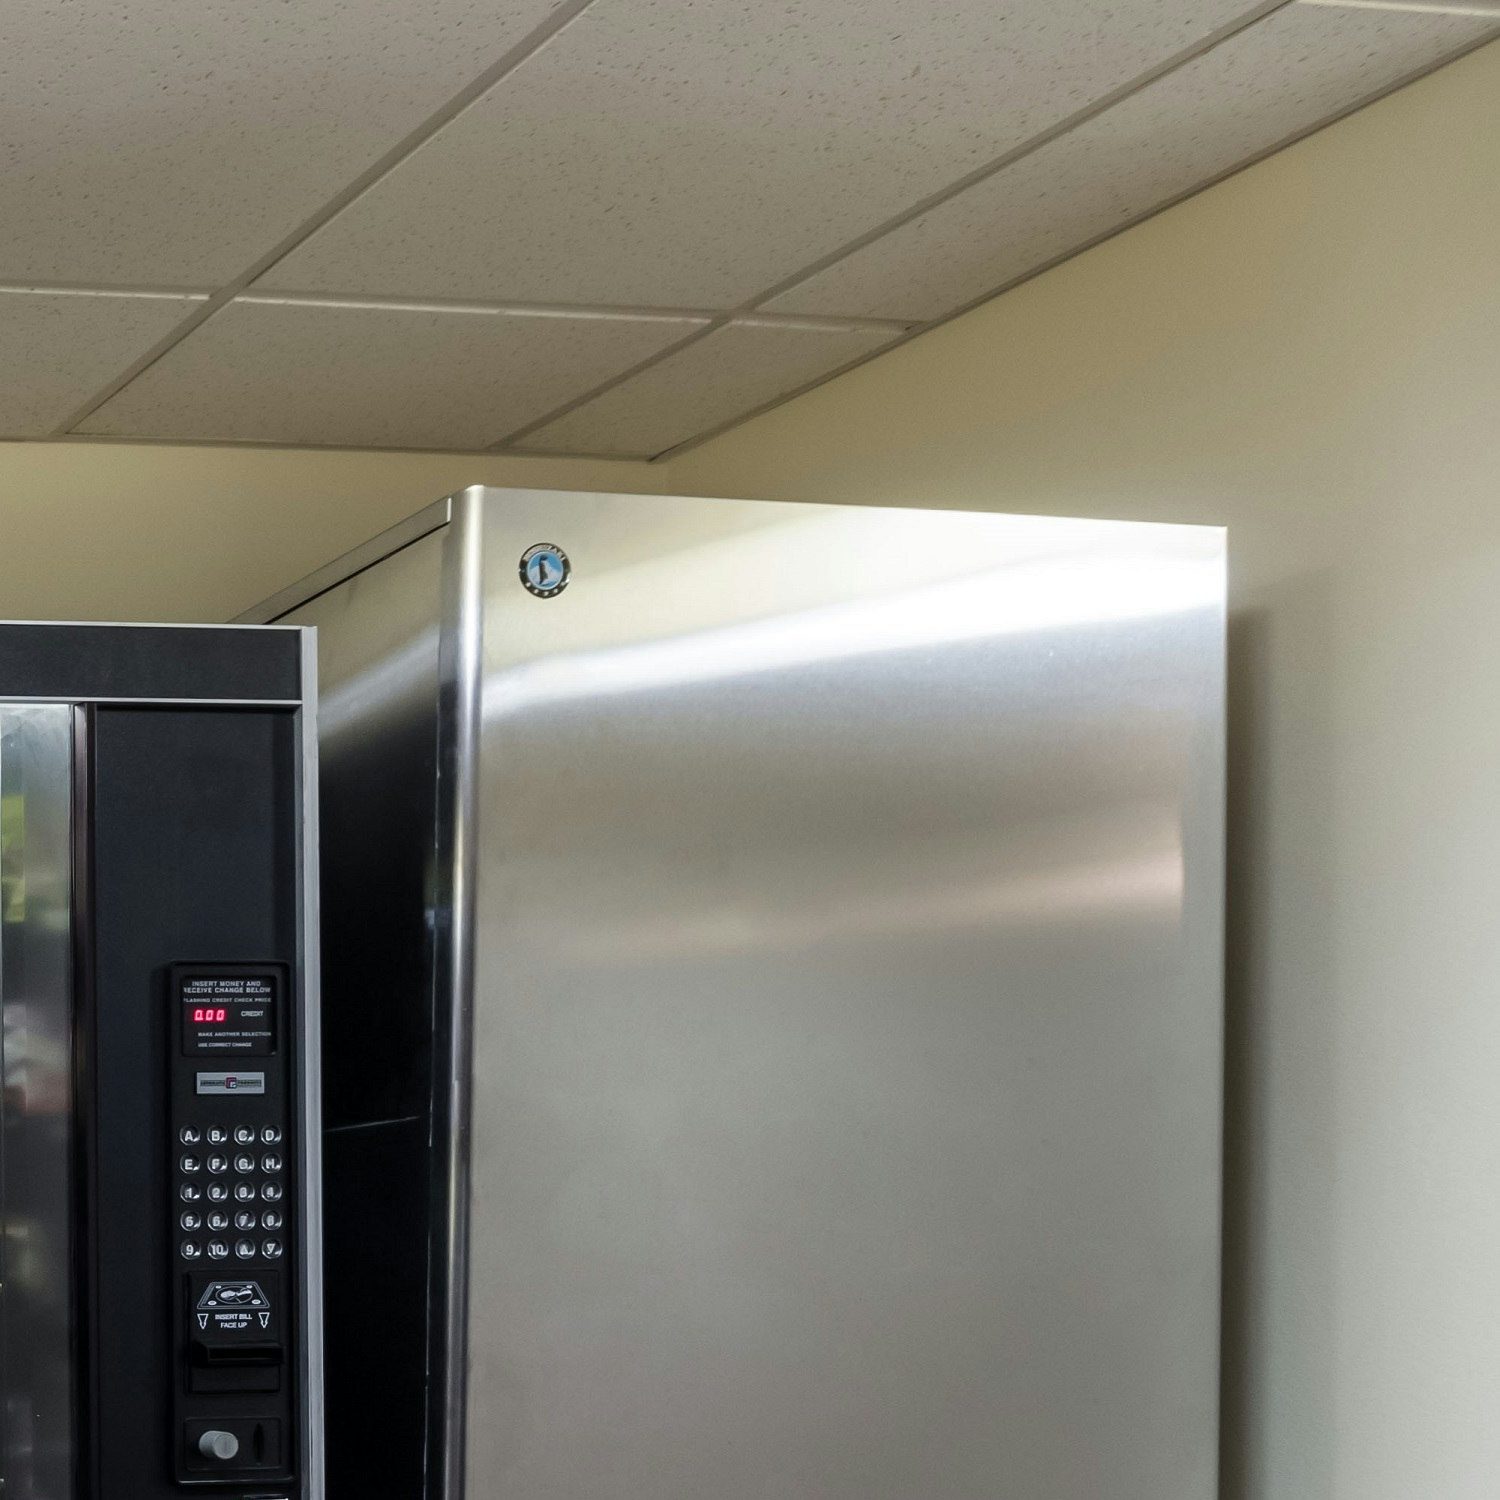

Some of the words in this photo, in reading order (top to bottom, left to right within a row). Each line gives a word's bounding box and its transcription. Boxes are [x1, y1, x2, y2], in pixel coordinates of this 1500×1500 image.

[185, 1130, 194, 1140] A
[211, 1130, 220, 1140] B
[238, 1130, 248, 1140] C
[265, 1130, 274, 1140] D
[185, 1158, 194, 1169] E
[211, 1158, 220, 1169] F
[238, 1158, 248, 1169] G
[265, 1158, 274, 1169] H
[211, 1187, 220, 1198] 2
[211, 1216, 220, 1226] 6
[238, 1216, 248, 1226] 7
[186, 1244, 194, 1255] 9
[211, 1244, 224, 1255] 10
